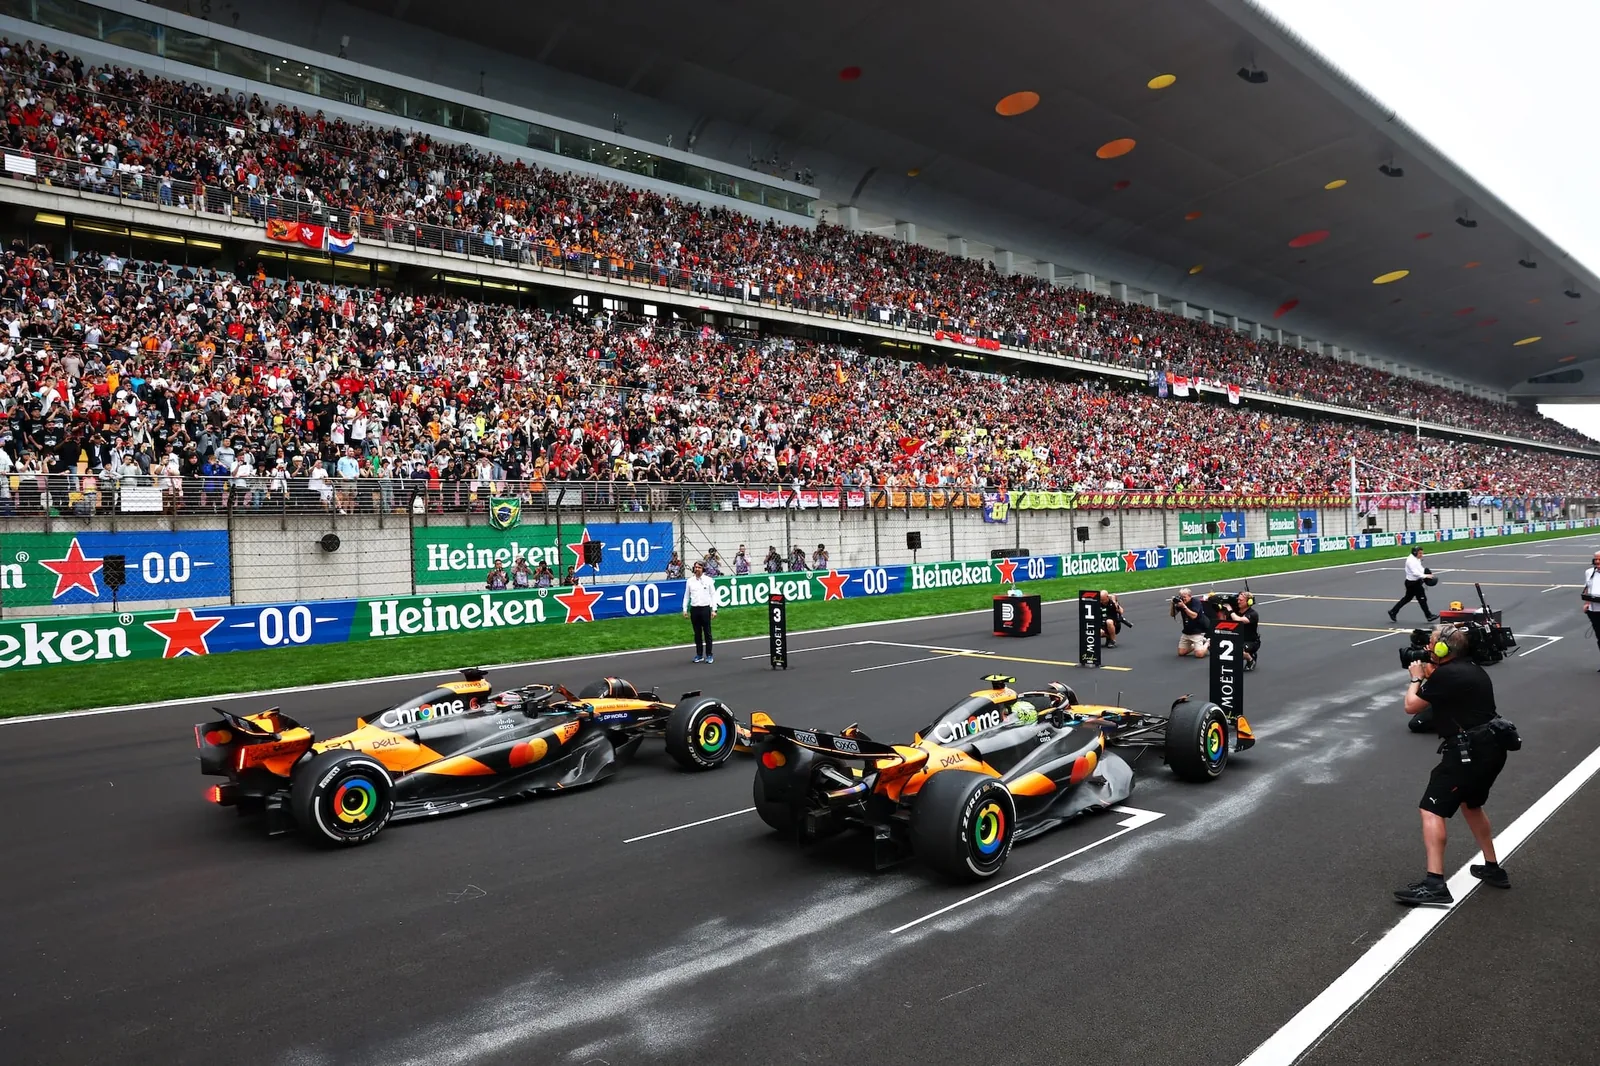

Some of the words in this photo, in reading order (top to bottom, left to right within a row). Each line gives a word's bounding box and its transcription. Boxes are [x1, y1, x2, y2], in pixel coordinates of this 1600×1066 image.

[992, 502, 1009, 520] 81
[426, 541, 560, 571] Heineken
[622, 538, 650, 562] 0.0
[1171, 548, 1215, 565] Heineken
[1234, 544, 1245, 560] 0.0
[1255, 541, 1289, 558] Heineken
[142, 552, 190, 583] 0.0
[911, 562, 992, 590] Heineken
[1027, 557, 1046, 579] 0.0
[1062, 554, 1120, 576] Heineken
[1145, 550, 1159, 568] 0.0
[863, 568, 888, 594] 0.0
[368, 594, 547, 637] Heineken
[624, 583, 659, 615] 0.0
[773, 608, 781, 622] 3
[1085, 604, 1095, 619] 1
[258, 606, 313, 646] 0.0
[1219, 640, 1234, 661] 2
[1219, 665, 1234, 708] MOËT
[379, 699, 464, 728] Chrome
[934, 709, 1000, 744] Chrome
[372, 737, 400, 749] DELL
[795, 733, 817, 744] OXXO
[835, 740, 858, 751] OXXO
[940, 753, 964, 768] DELL
[961, 789, 981, 830] ZERO
